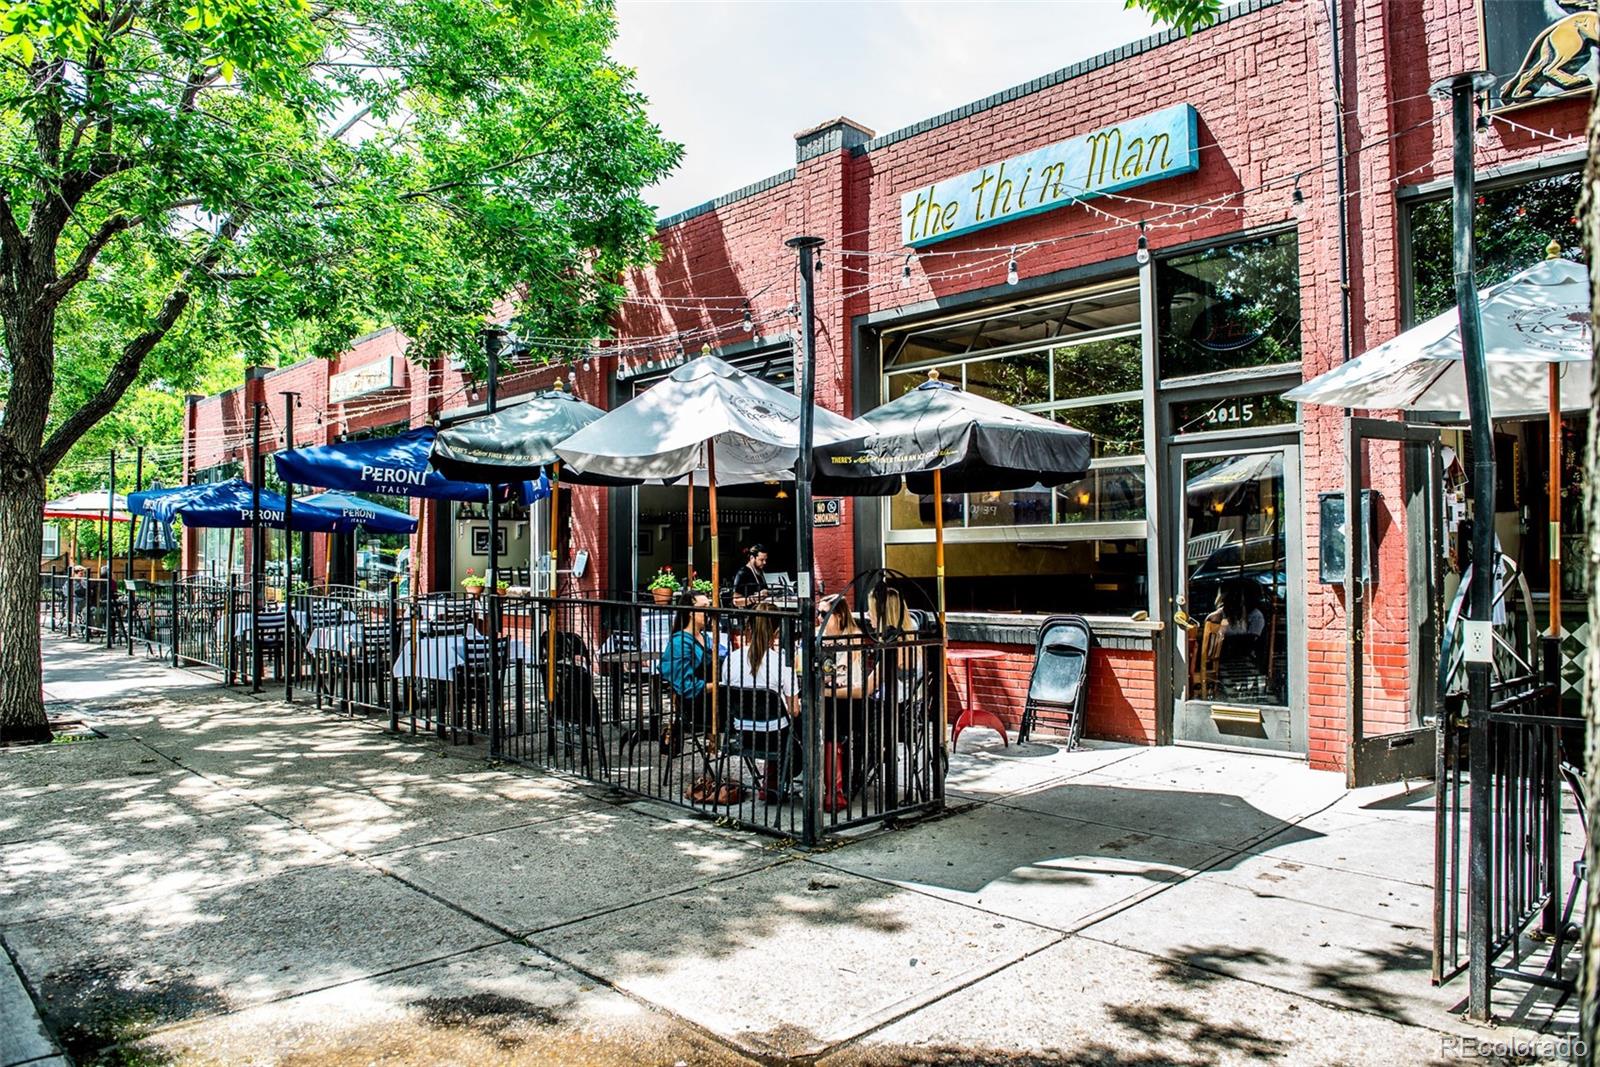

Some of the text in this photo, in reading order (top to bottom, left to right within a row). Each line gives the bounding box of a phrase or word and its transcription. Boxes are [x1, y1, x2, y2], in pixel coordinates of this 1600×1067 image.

[907, 127, 1174, 242] the thin Man
[1207, 404, 1254, 424] 2015
[831, 456, 853, 464] THERE'S
[360, 465, 427, 486] PERONI
[375, 485, 409, 494] ITALY
[816, 502, 826, 513] NO
[342, 508, 377, 521] PERONI
[814, 513, 840, 525] SMOKING
